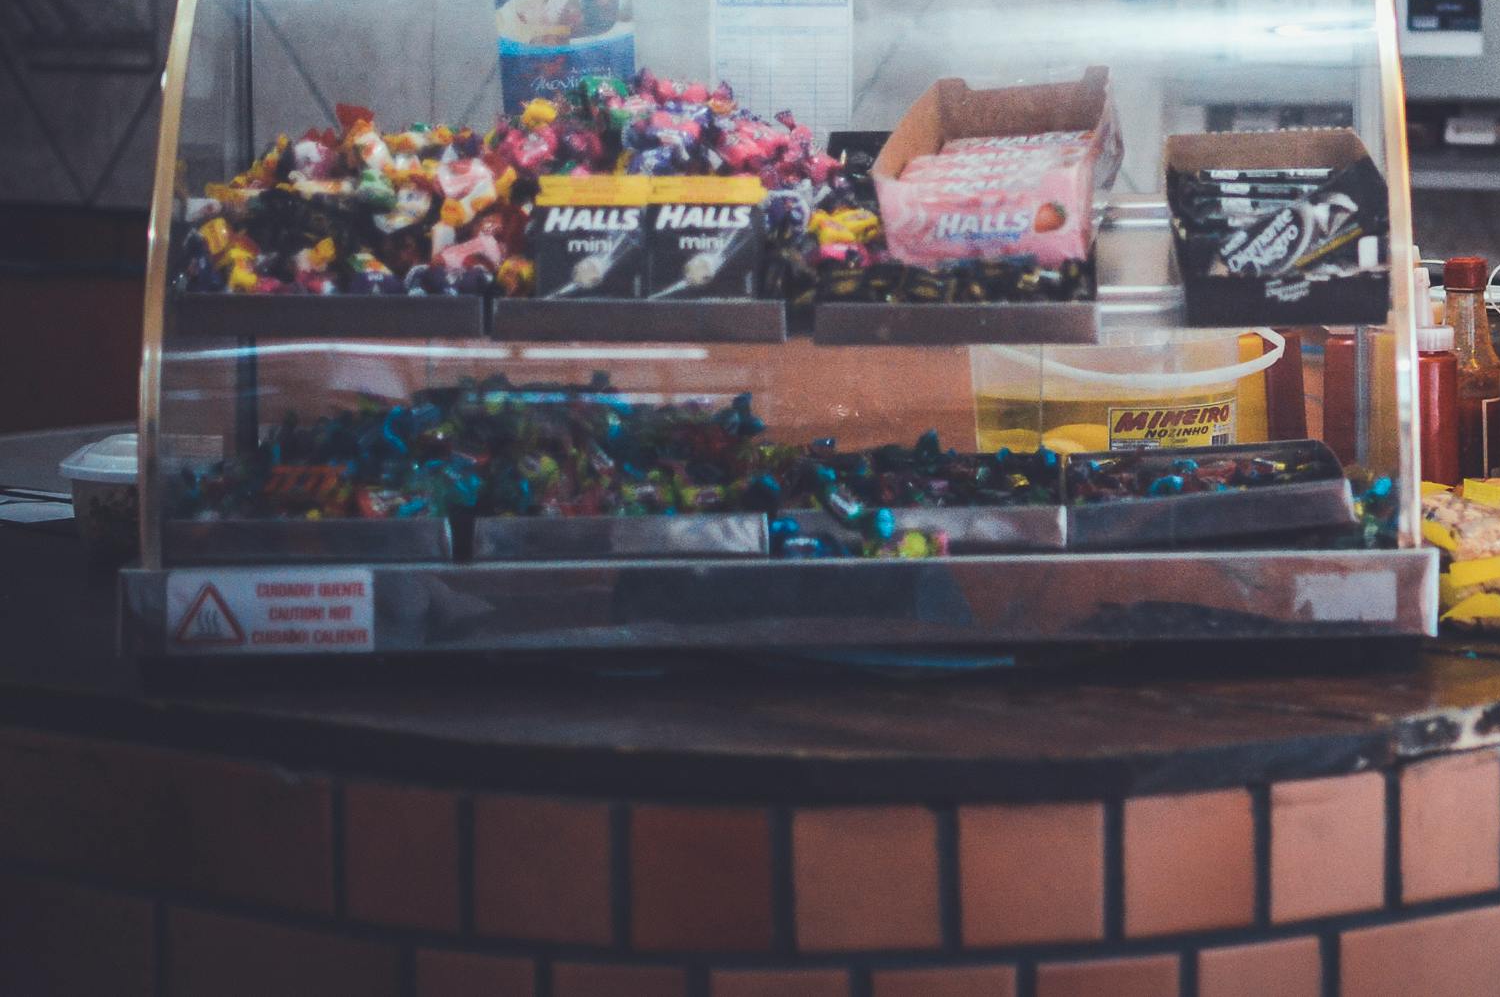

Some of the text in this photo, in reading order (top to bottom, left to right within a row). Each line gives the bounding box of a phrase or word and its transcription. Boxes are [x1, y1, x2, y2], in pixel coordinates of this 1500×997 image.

[544, 206, 641, 233] HALLS
[655, 204, 752, 231] HALLS
[934, 210, 1032, 239] HALLS
[567, 237, 613, 253] mini
[678, 234, 724, 251] mini
[1114, 404, 1230, 434] MINEIRO
[1144, 425, 1209, 439] NOZINHO
